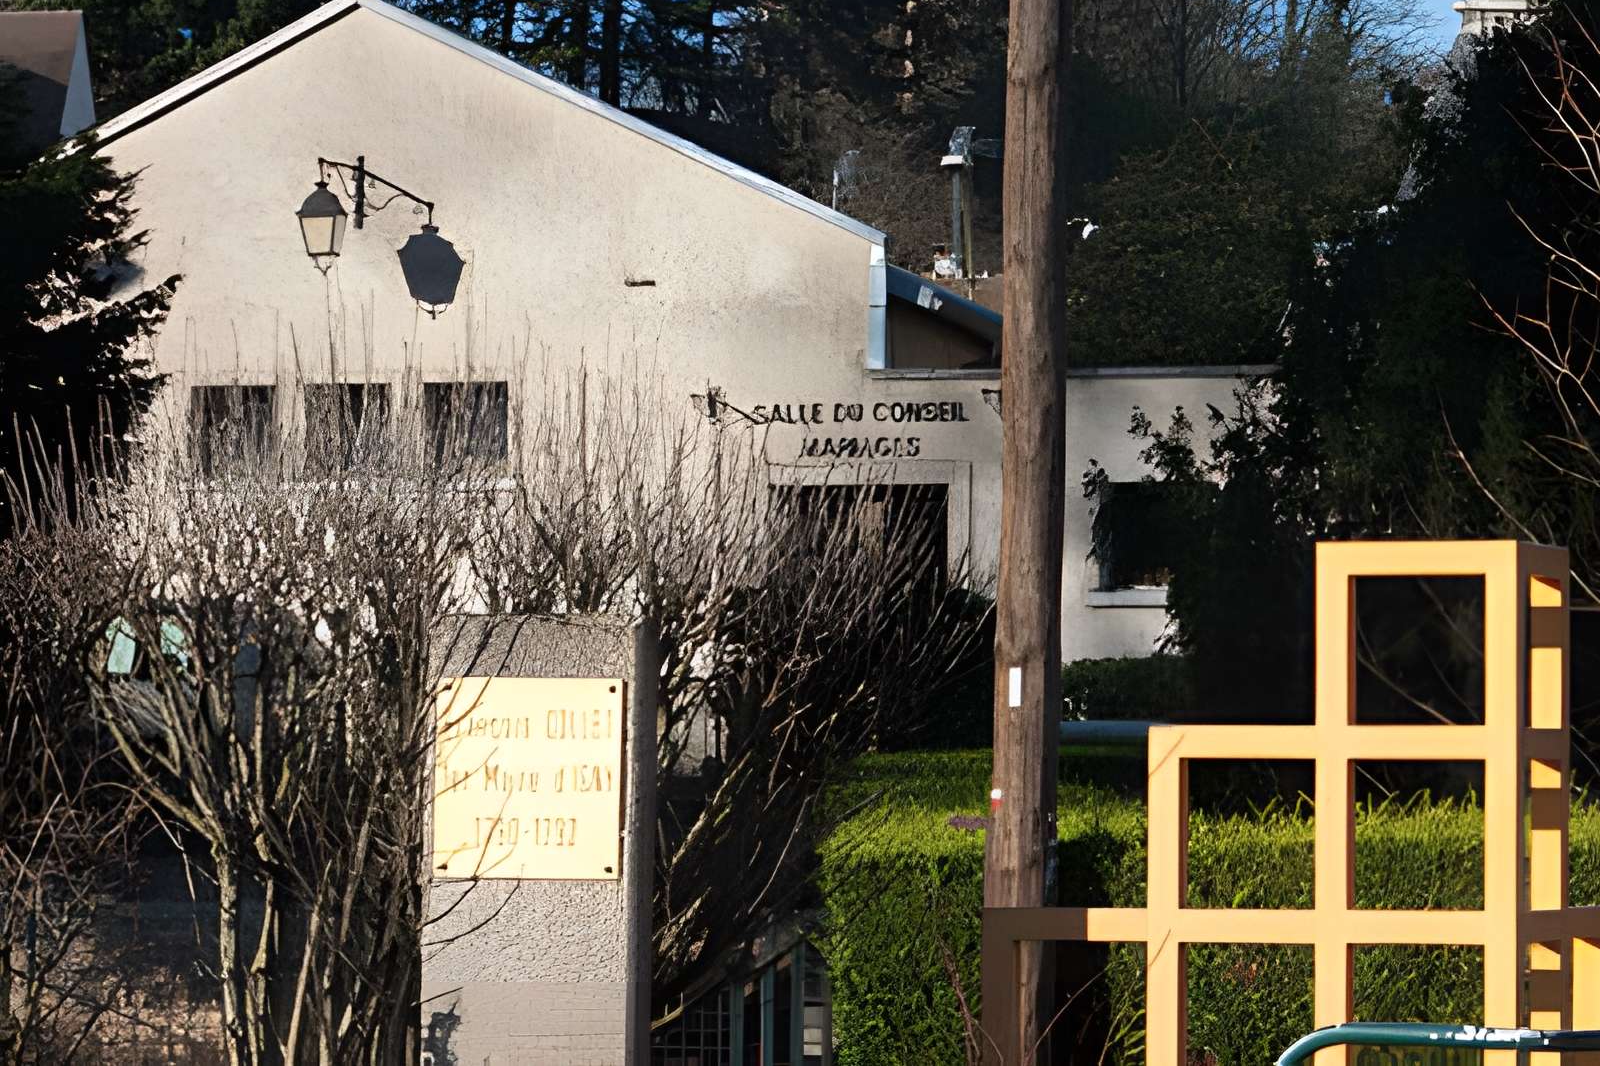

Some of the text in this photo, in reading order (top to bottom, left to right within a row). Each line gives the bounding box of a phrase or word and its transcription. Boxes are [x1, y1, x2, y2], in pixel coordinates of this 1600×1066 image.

[753, 401, 970, 424] SALLE DU CONSEIL
